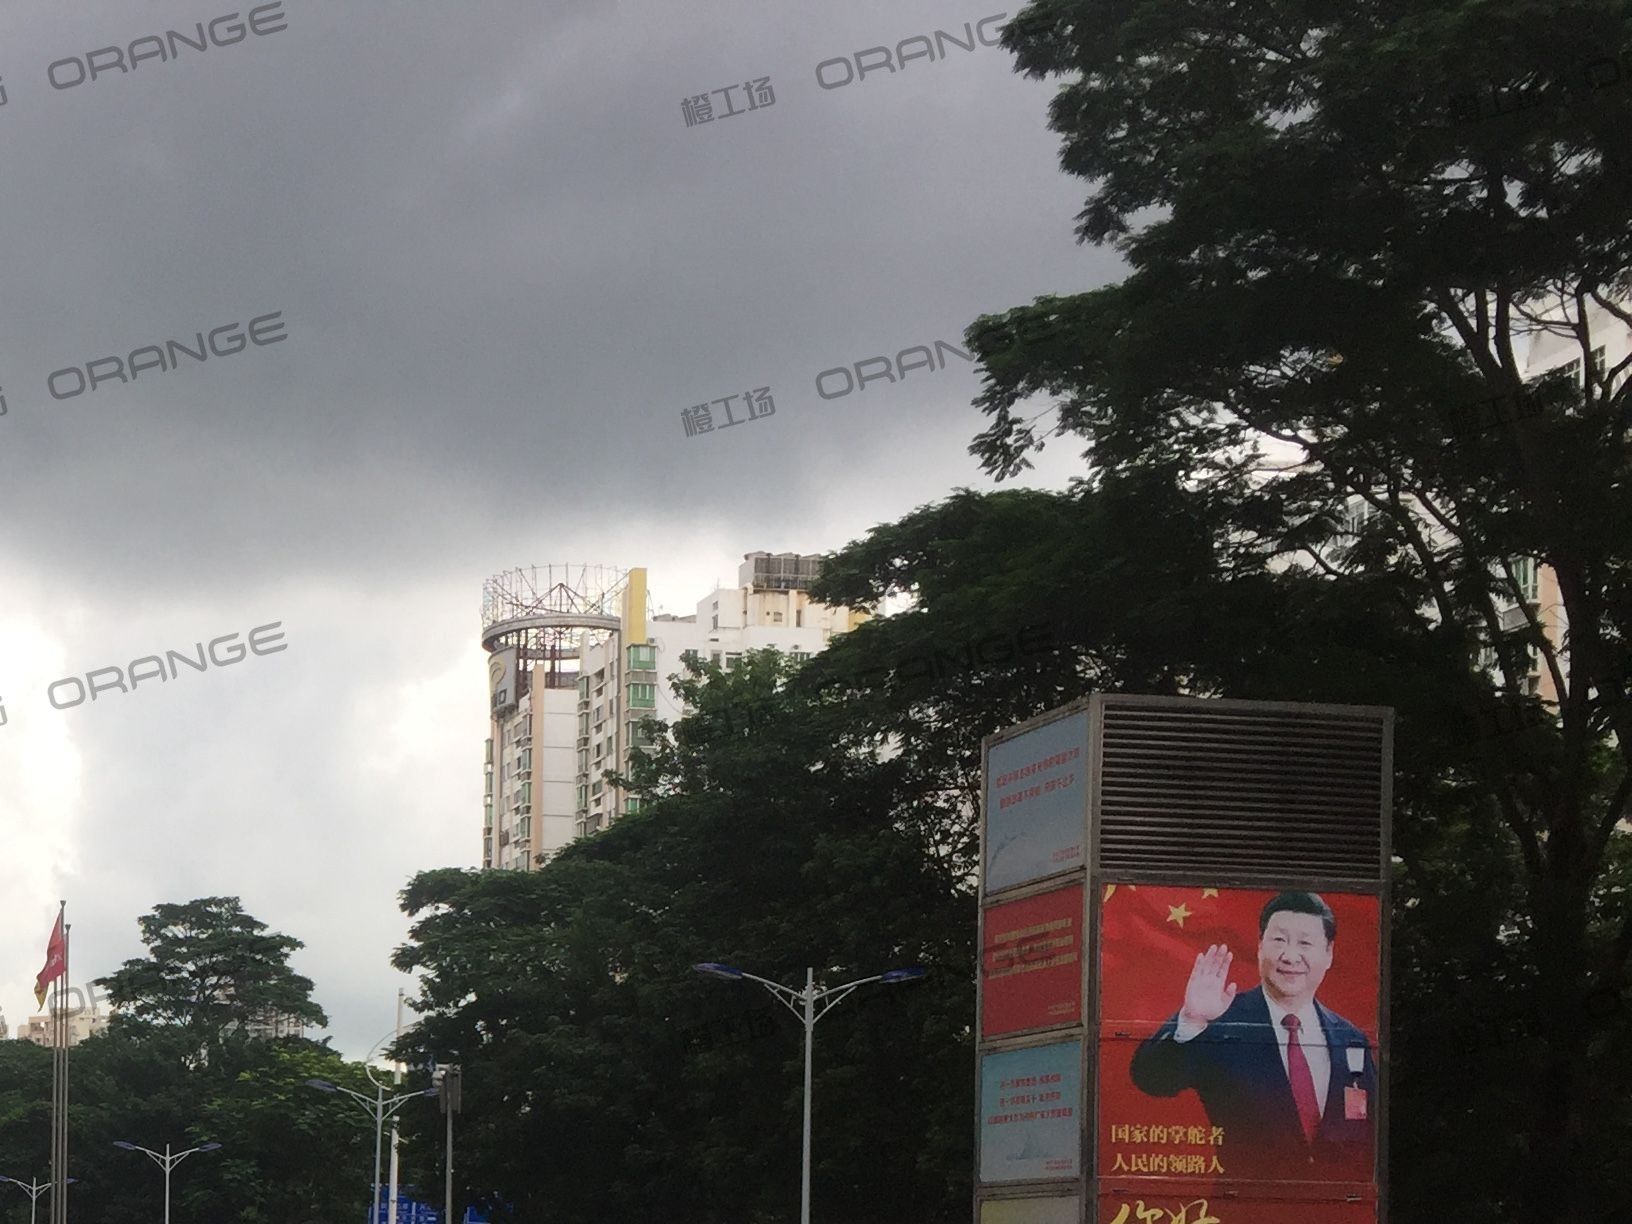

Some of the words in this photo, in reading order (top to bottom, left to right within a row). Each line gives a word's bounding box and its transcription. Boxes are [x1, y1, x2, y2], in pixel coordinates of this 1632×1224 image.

[1111, 1124, 1225, 1145] 国家的掌舵者
[1111, 1153, 1225, 1174] 人民的领路人
